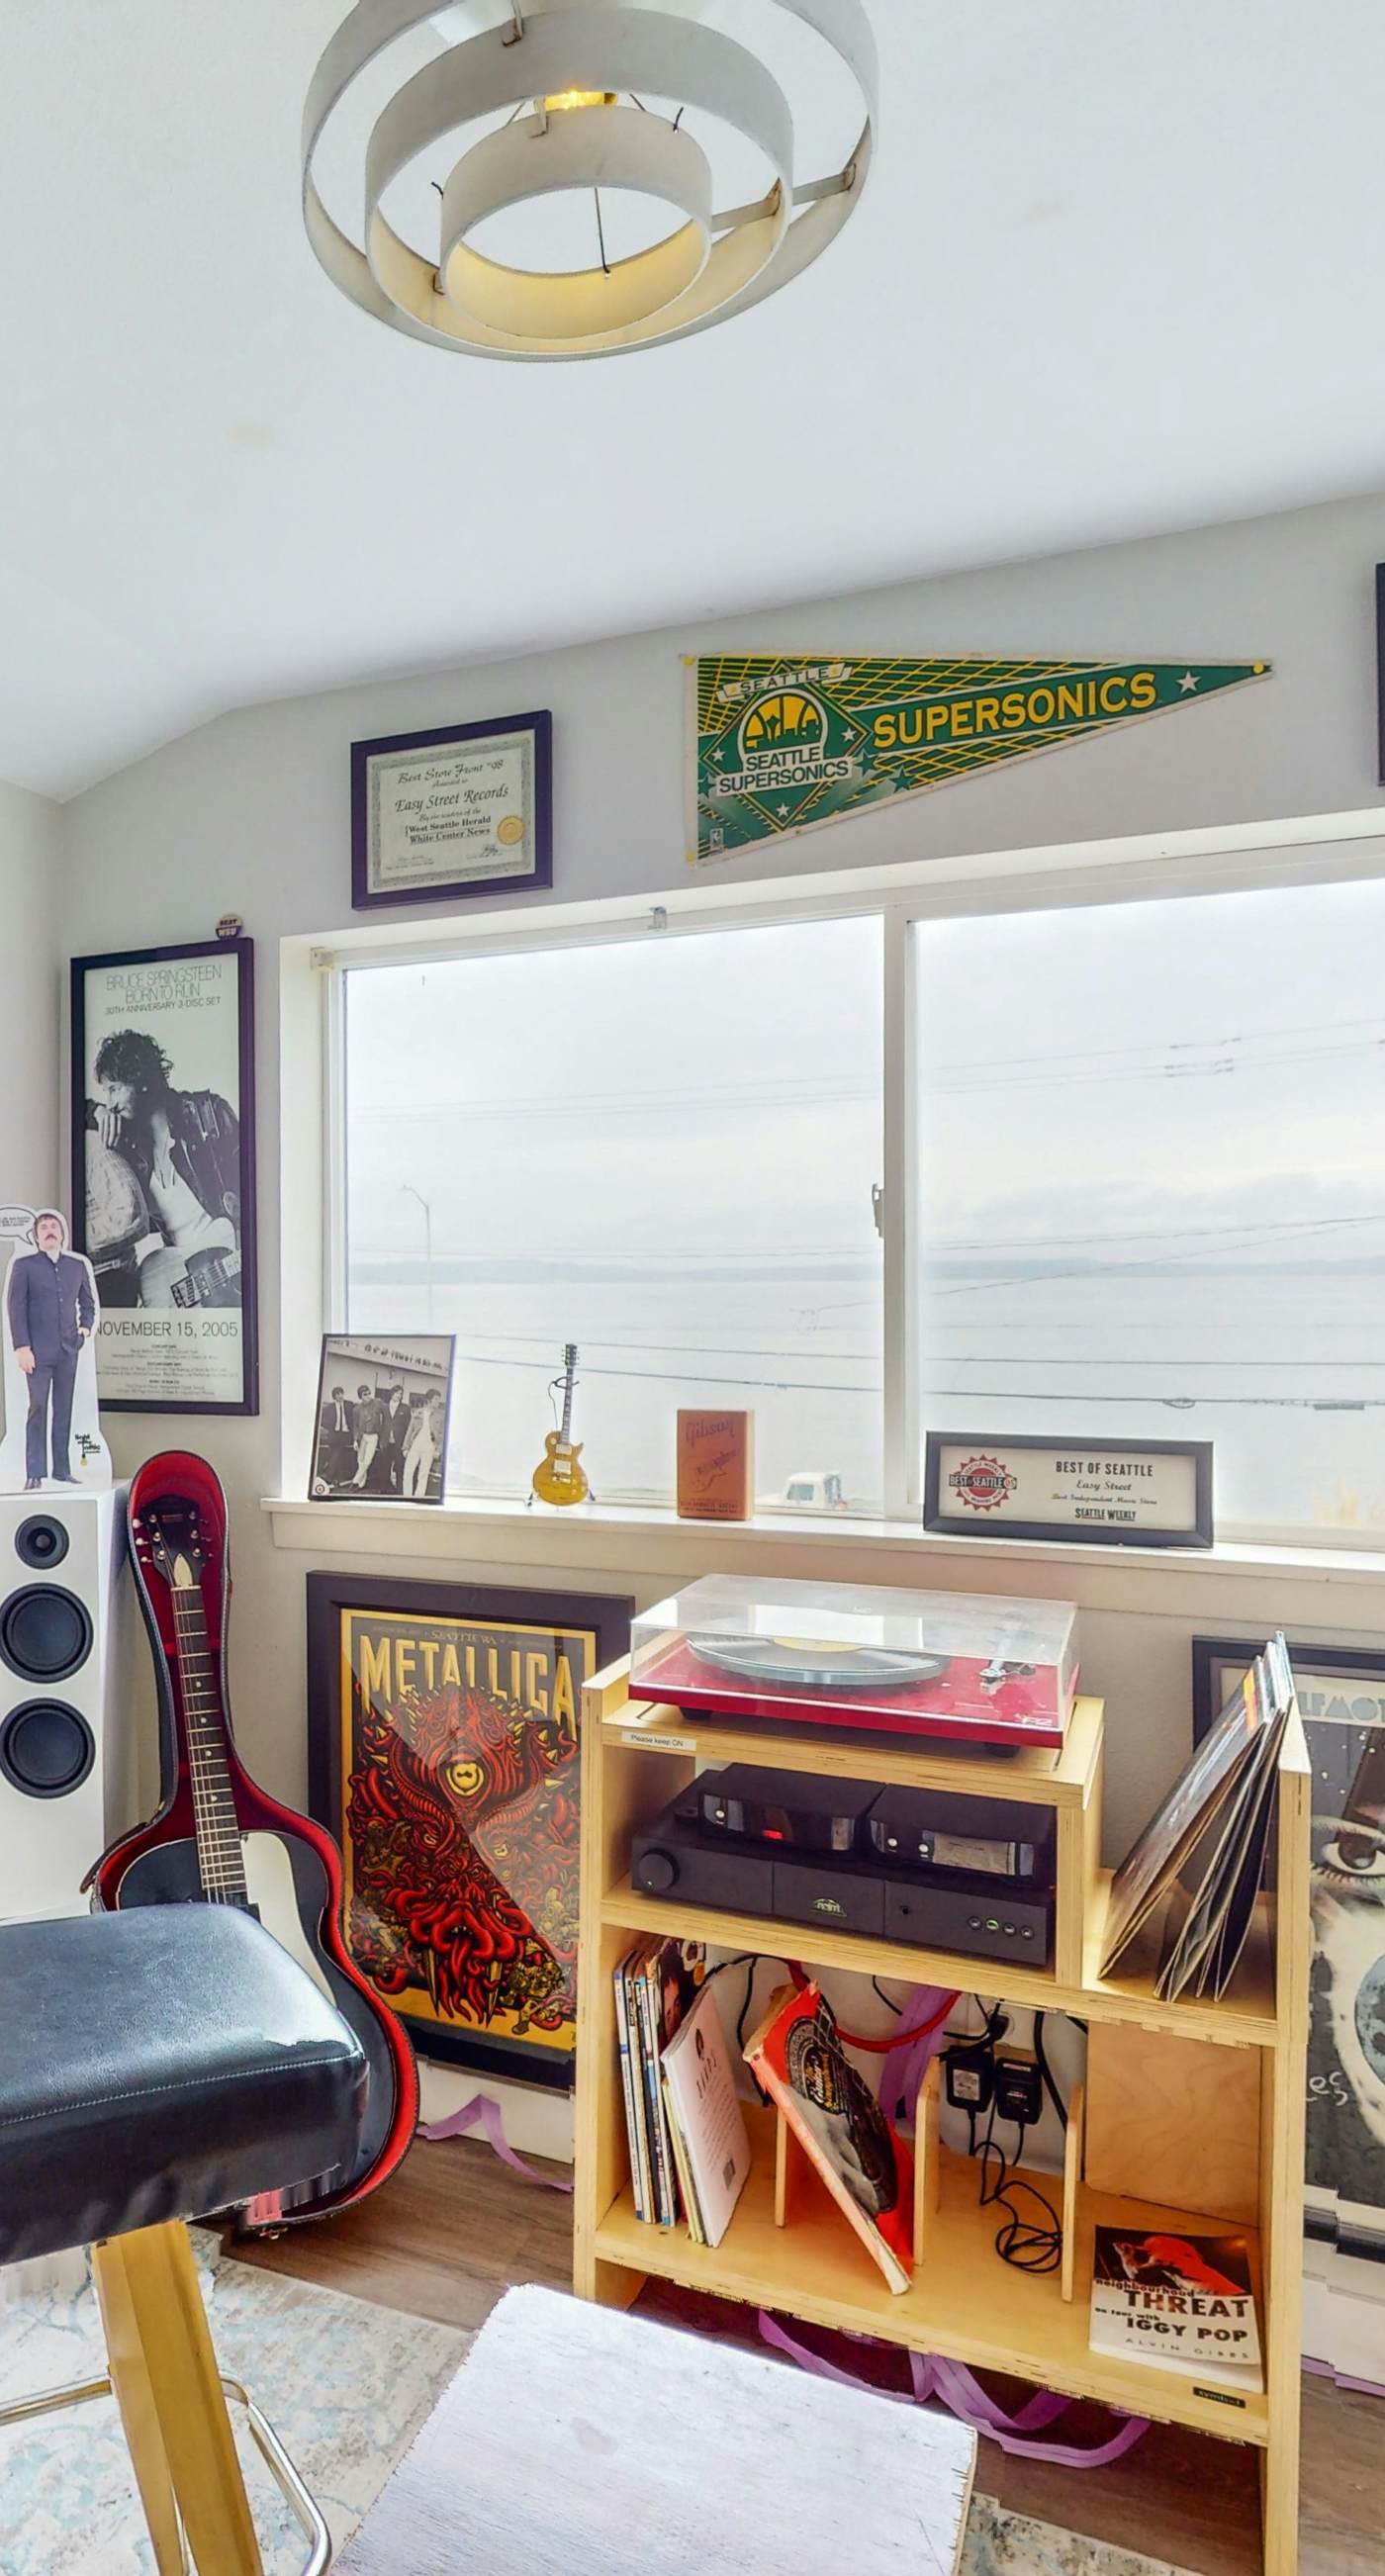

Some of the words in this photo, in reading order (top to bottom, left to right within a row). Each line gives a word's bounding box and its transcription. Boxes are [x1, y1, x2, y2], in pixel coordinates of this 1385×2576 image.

[740, 667, 829, 692] SEATTLE
[873, 672, 1156, 749] SUPERSONICS
[746, 746, 821, 772] SEATTLE
[398, 773, 421, 784] Best
[424, 768, 452, 781] Store
[455, 764, 483, 778] Front
[719, 760, 849, 792] SUPERSONICS
[395, 798, 423, 815] Easy
[425, 792, 460, 809] Street
[464, 782, 508, 804] Records
[429, 820, 459, 831] Seattle
[461, 815, 491, 827] Herald
[410, 833, 433, 845] White
[435, 829, 464, 842] Center
[466, 827, 491, 838] News
[106, 973, 143, 991] BRUCE
[146, 964, 222, 987] SPRINGSTEEN
[126, 987, 158, 1005] BORN
[159, 984, 174, 1000] TO
[175, 982, 201, 999] RUN
[126, 1001, 175, 1013] ANNIVERSARY
[206, 996, 222, 1006] SET
[177, 1321, 197, 1337] 15,
[202, 1322, 238, 1337] 2005
[685, 1417, 736, 1448] Gibson
[1056, 1461, 1083, 1474] BEST
[1087, 1462, 1101, 1474] OF
[1104, 1463, 1154, 1477] SEATTLE
[949, 1475, 968, 1486] BEST
[972, 1476, 1003, 1488] SEATTLE
[1076, 1480, 1100, 1491] Easy
[1104, 1481, 1132, 1491] Street
[1074, 1508, 1105, 1519] SEATTLE
[1107, 1510, 1137, 1521] WEEKLY
[359, 1634, 577, 1743] METALLICA
[631, 1734, 653, 1743] Please
[654, 1736, 670, 1746] keep
[1095, 2278, 1195, 2298] neighbourhood
[1124, 2289, 1248, 2318] THREAT
[1136, 2313, 1160, 2322] with
[1127, 2318, 1187, 2337] IGGY
[1197, 2327, 1248, 2343] POP
[1125, 2338, 1180, 2351] ALVIN
